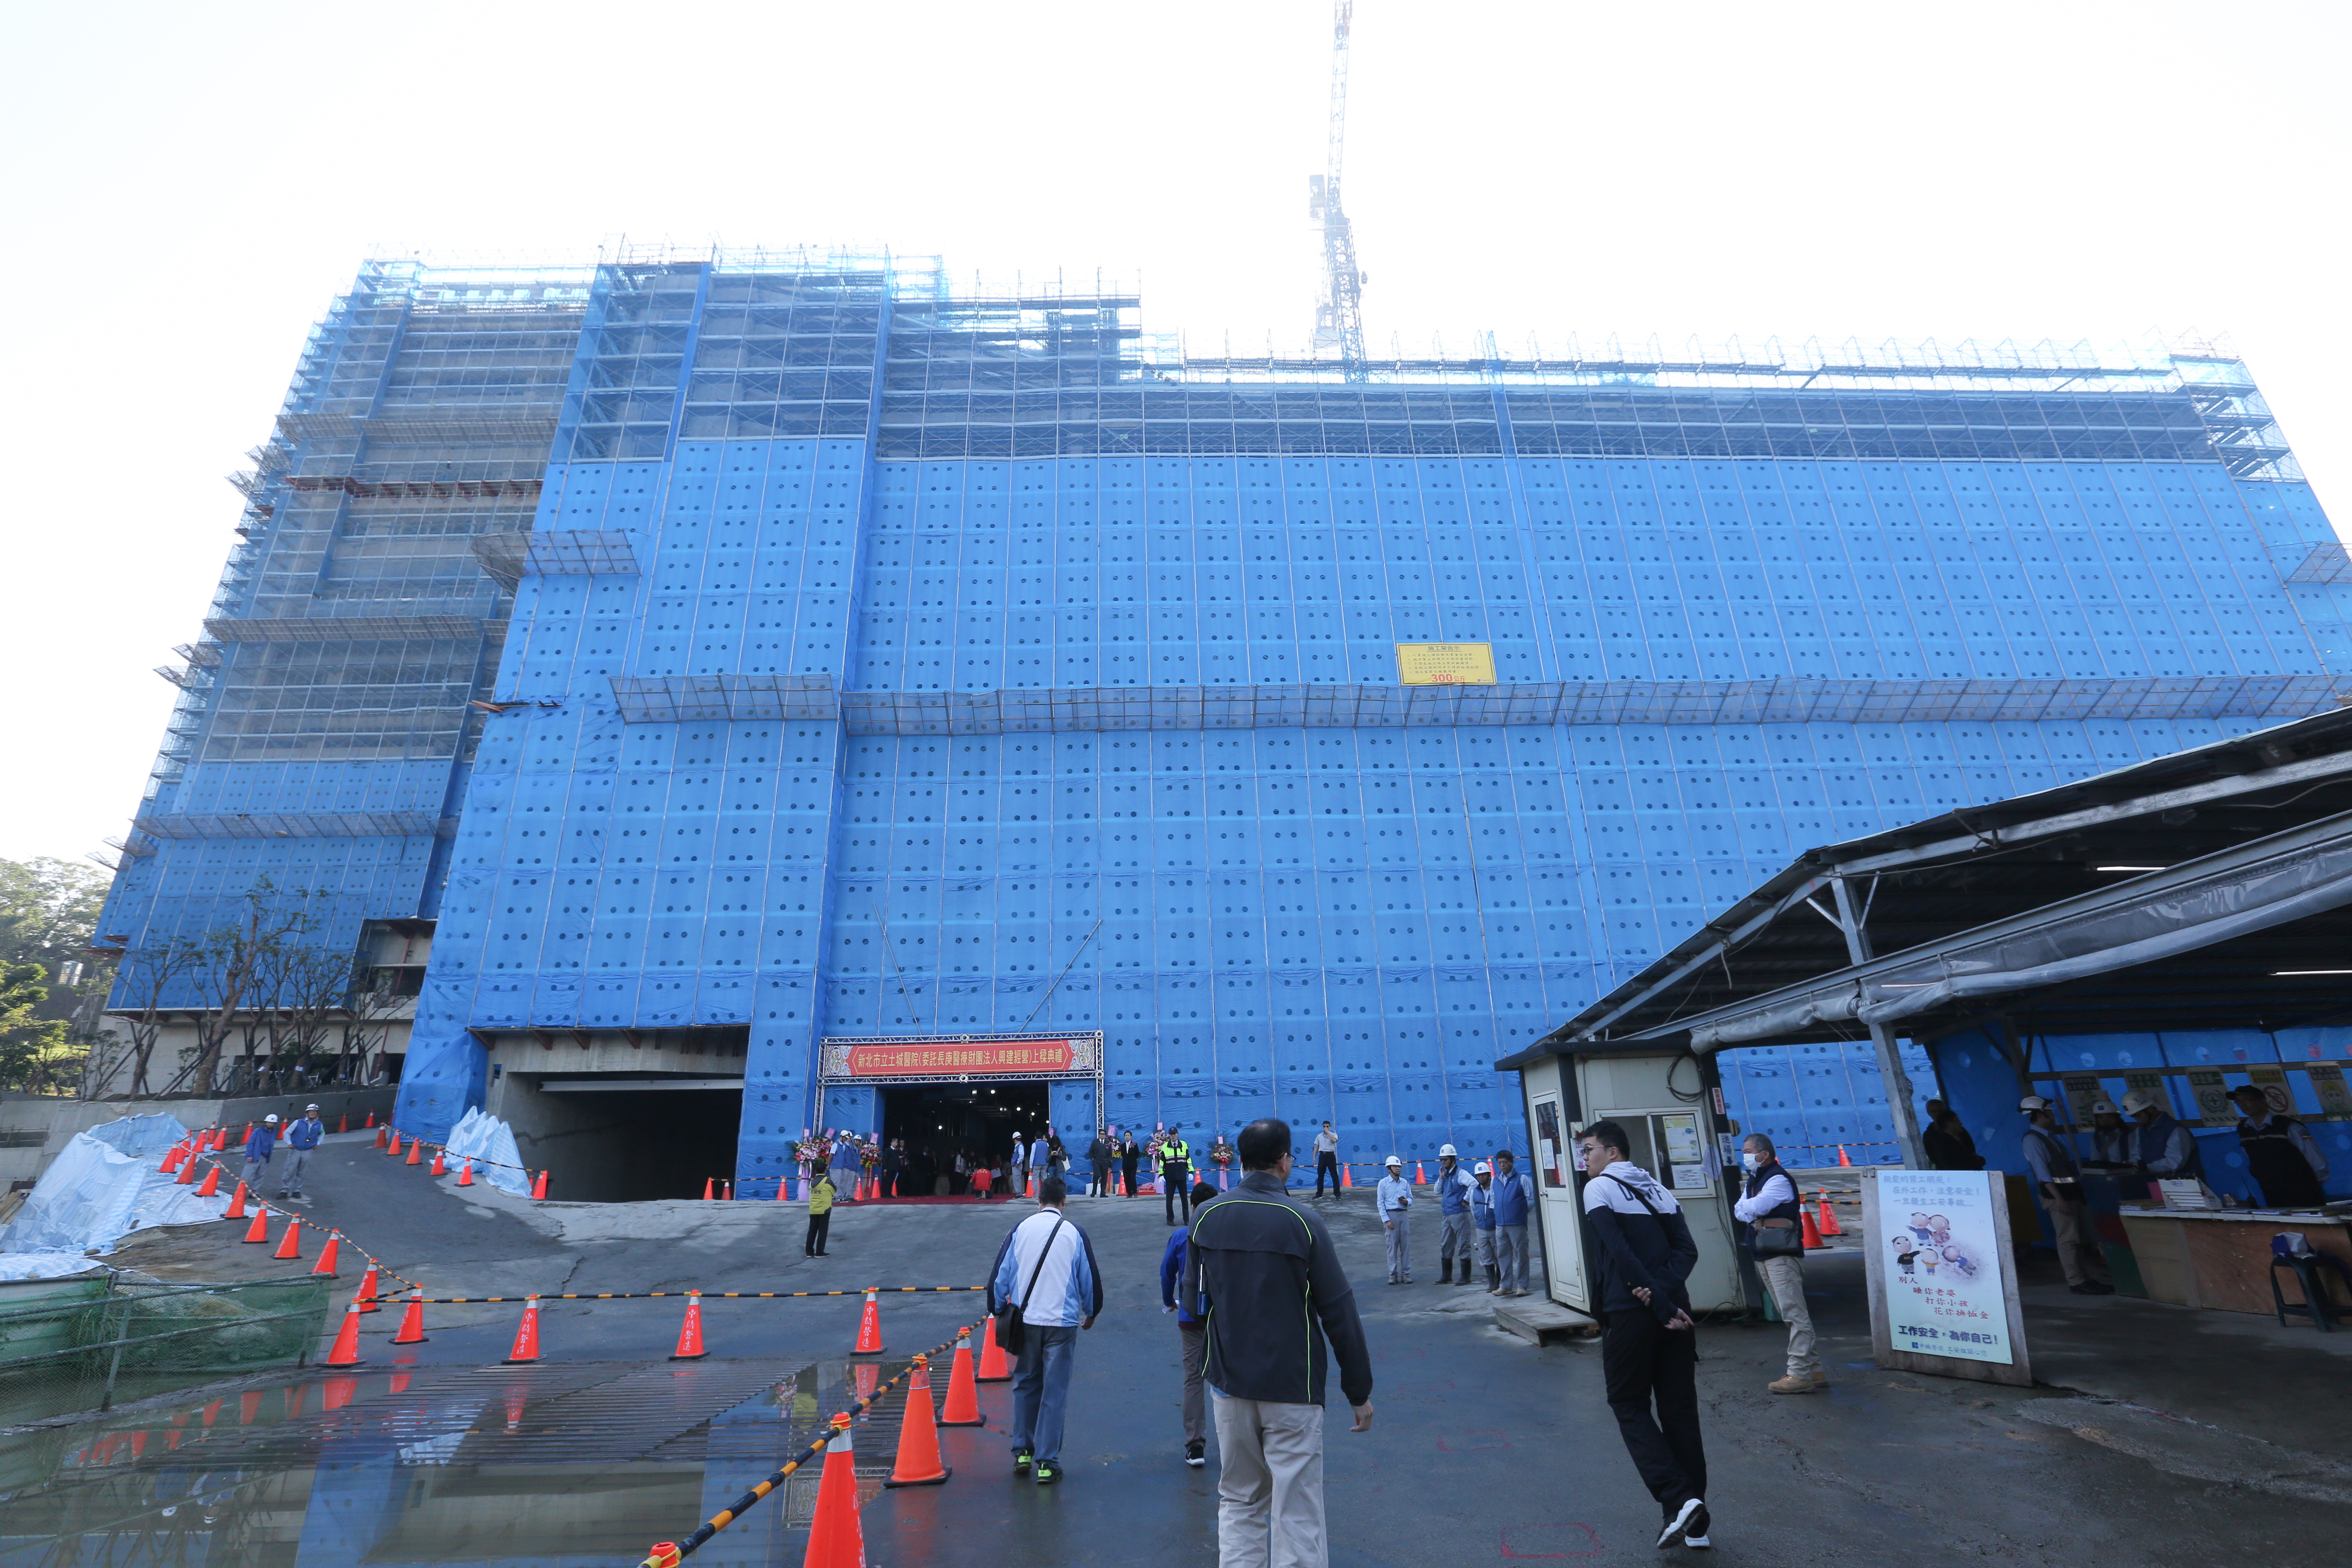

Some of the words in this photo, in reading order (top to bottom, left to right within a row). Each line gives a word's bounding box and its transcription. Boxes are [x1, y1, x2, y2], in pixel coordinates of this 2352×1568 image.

[858, 1048, 1062, 1067] 新北市立土城醫院(委託長庚醫療財團法人興建經營)上樑典禮
[1722, 1136, 1732, 1155] 進場
[1913, 1287, 1956, 1297] 睡你老婆
[1925, 1296, 1969, 1307] 打你小孩
[1933, 1307, 1989, 1319] 花你撫恤金
